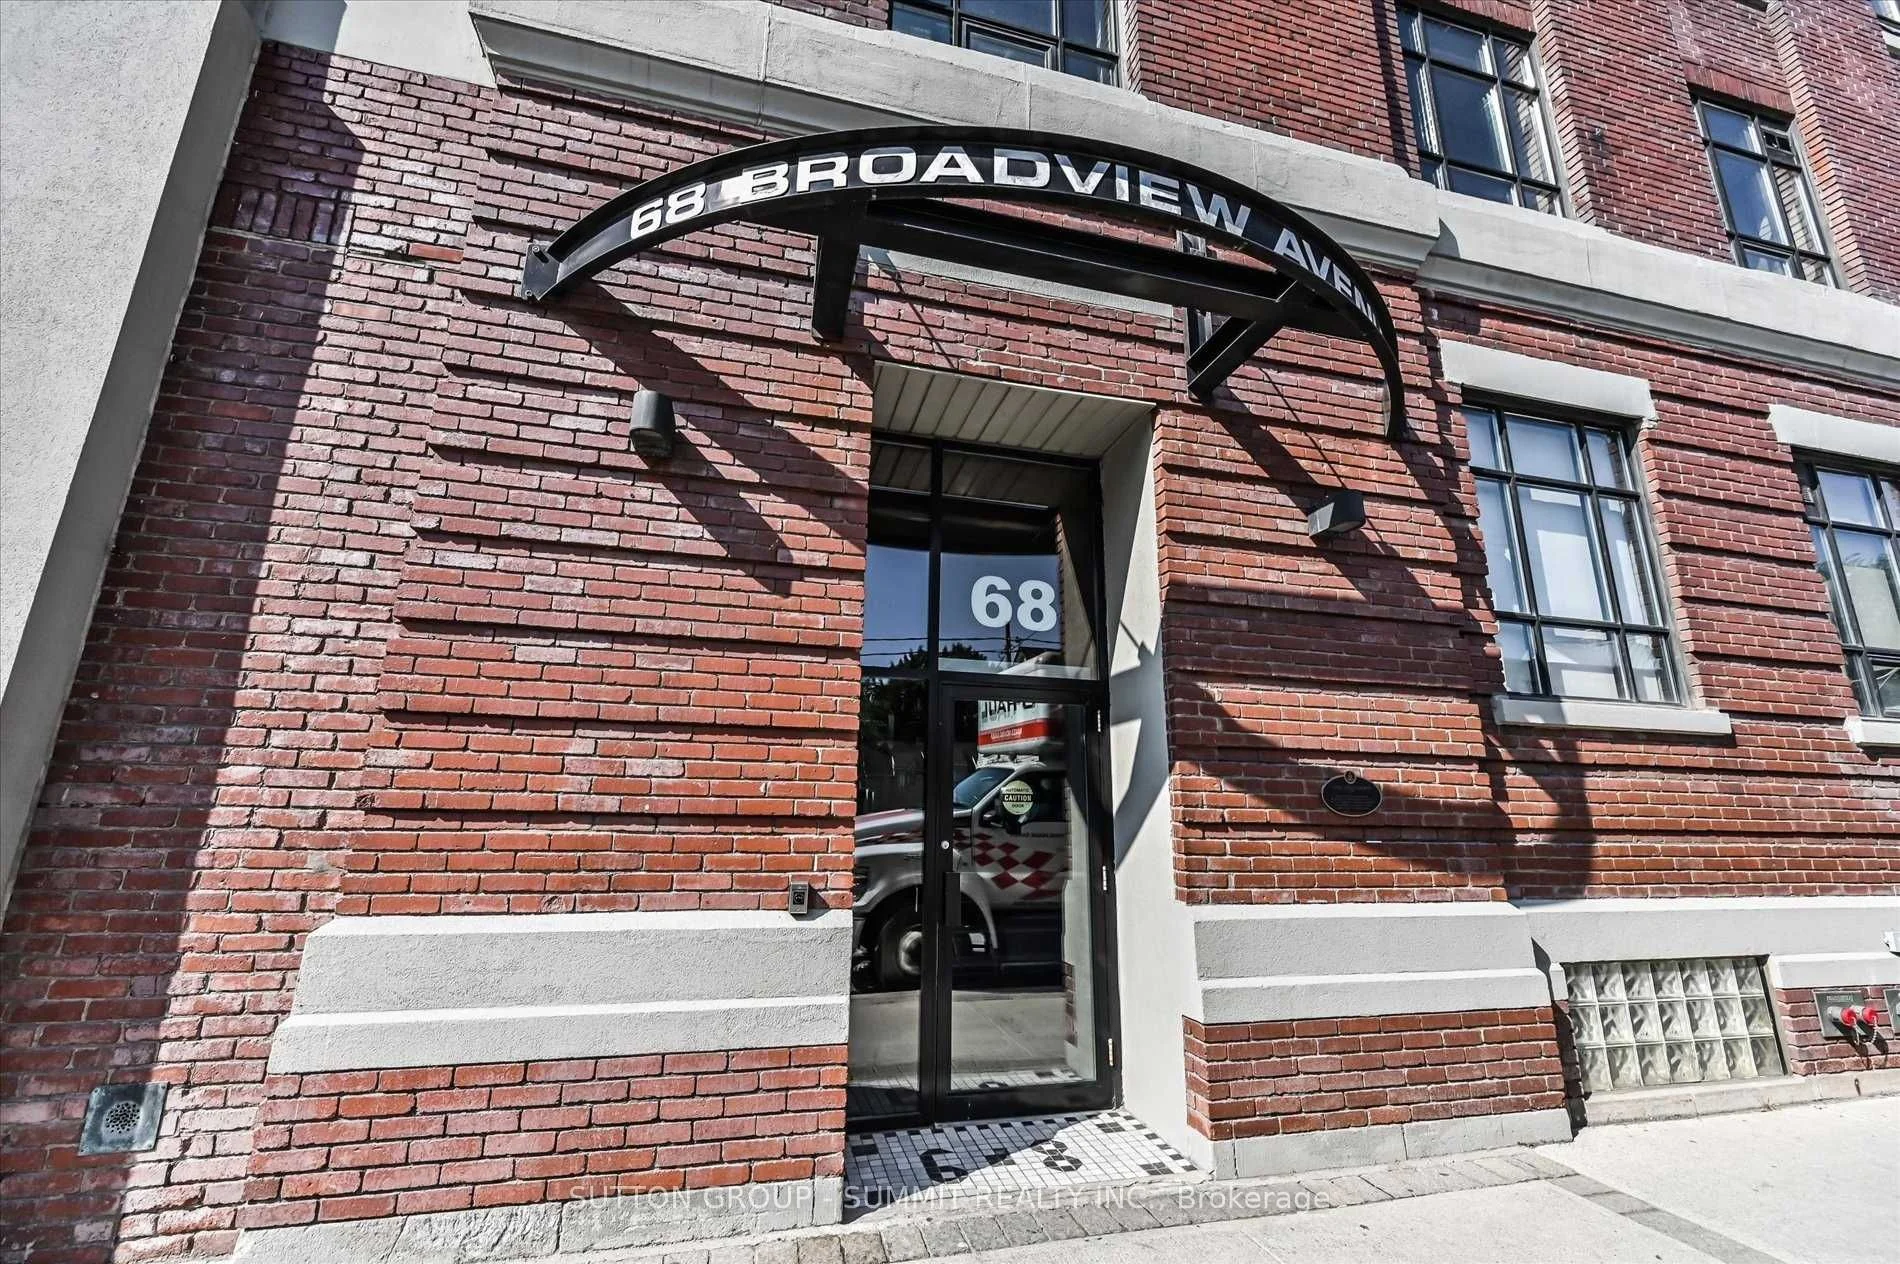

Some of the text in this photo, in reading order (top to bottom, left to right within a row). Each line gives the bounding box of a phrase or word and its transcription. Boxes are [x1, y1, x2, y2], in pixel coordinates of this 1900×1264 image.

[630, 182, 706, 240] 68
[738, 145, 1251, 237] BROADVIEW
[971, 575, 1057, 632] 68
